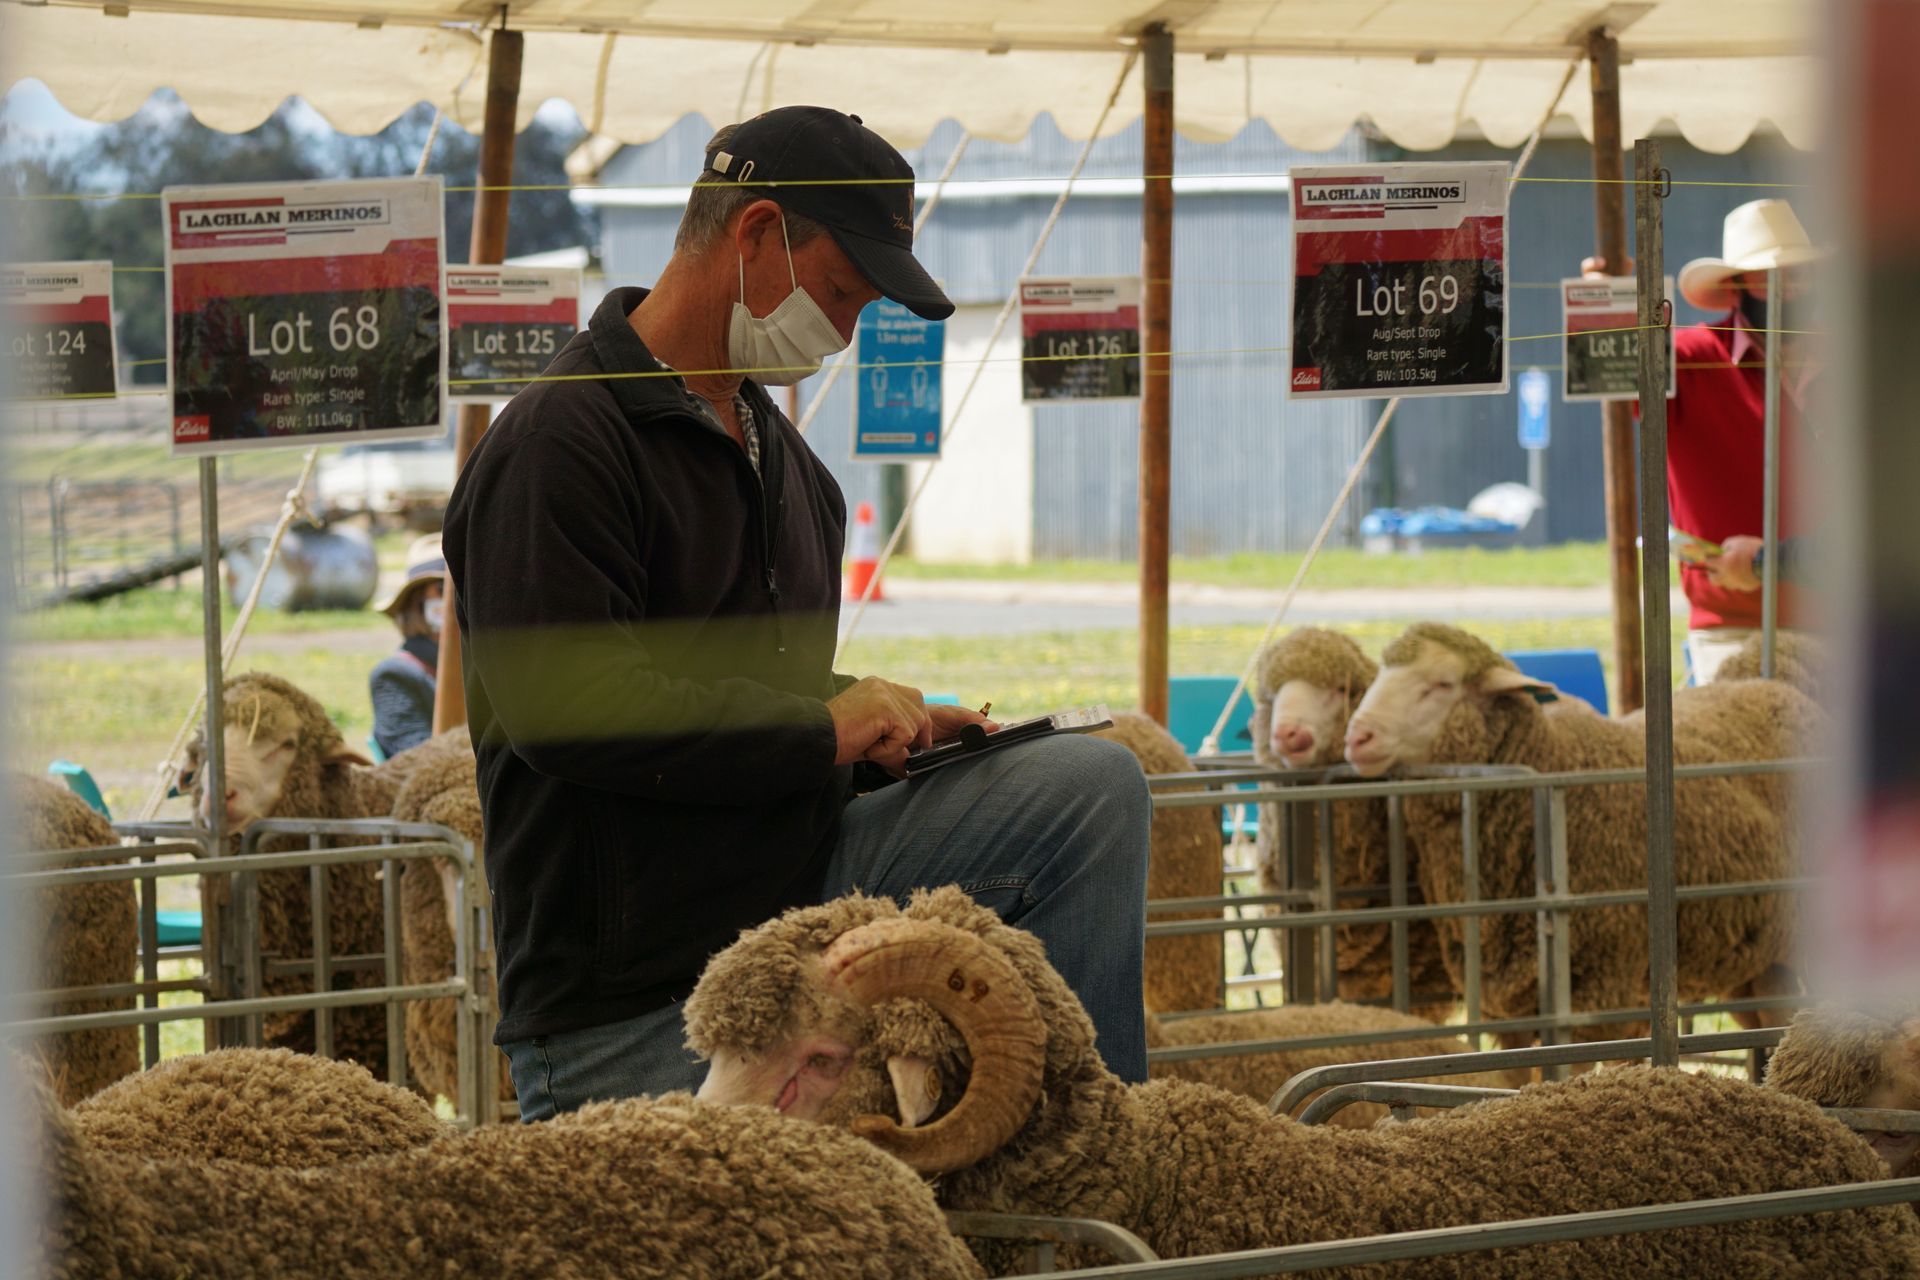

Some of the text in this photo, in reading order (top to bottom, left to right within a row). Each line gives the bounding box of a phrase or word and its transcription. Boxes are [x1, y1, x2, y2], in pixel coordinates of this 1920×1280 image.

[1306, 186, 1460, 201] LACHLAN MERINOS
[185, 206, 382, 228] LACHLAN MERINOS
[1356, 275, 1459, 317] Lot 69
[248, 305, 380, 357] Lot 68
[473, 329, 556, 354] Lot 125
[1373, 326, 1441, 341] Aug/Sept Drop
[10, 330, 86, 356] ot 124
[1048, 336, 1121, 360] Lot 126
[1588, 334, 1638, 358] Lot 12
[1367, 347, 1447, 362] Rare type: Single
[270, 364, 359, 385] April/May Drop
[1376, 369, 1437, 383] BW: 103.5kg
[263, 388, 365, 407] Rare type: Single
[276, 411, 353, 430] BW: 111.0kg
[947, 967, 990, 1004] 69
